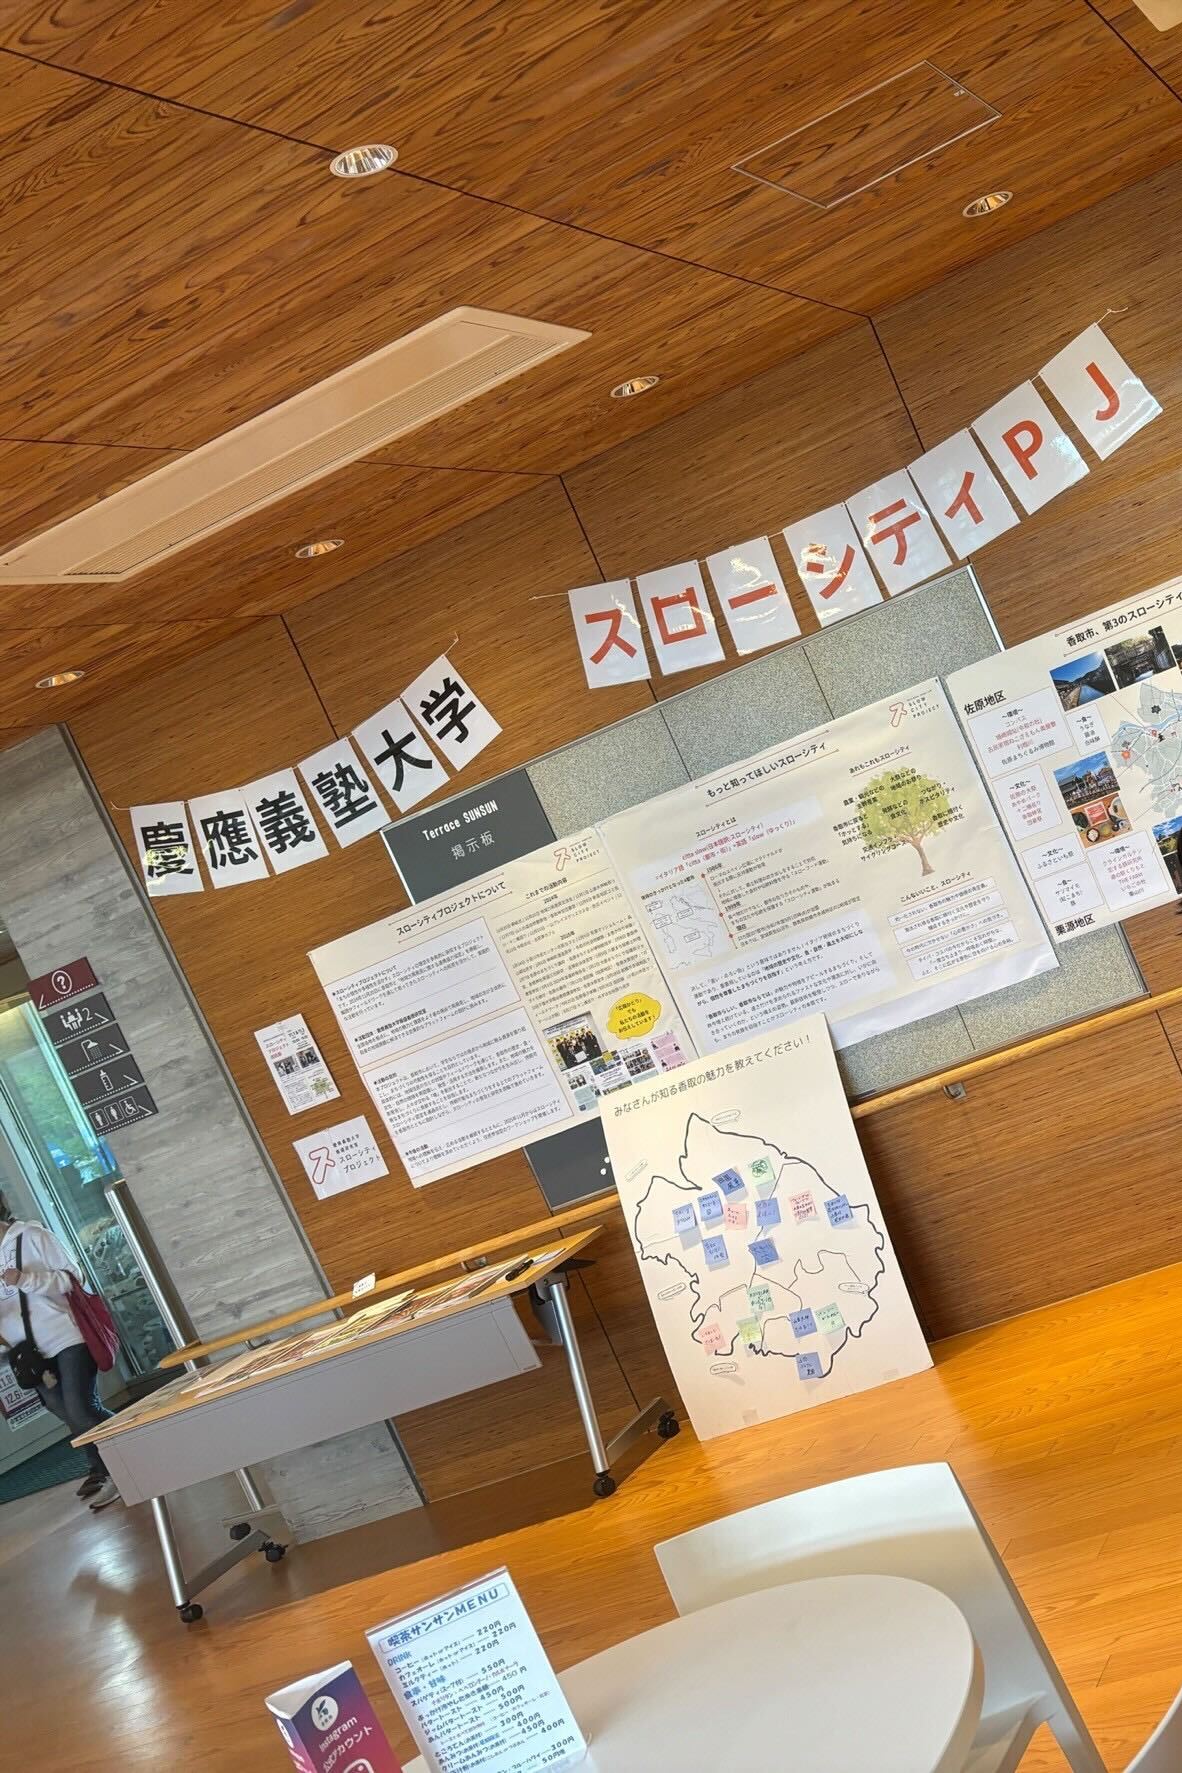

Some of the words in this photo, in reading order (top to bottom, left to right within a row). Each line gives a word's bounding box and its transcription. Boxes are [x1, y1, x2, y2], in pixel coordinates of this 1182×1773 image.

[962, 688, 1006, 716] 佐原地区
[139, 676, 478, 879] 慶應義塾大学
[705, 739, 828, 799] もっと知ってほしいスローシティ
[421, 816, 461, 842] Terrace
[461, 798, 499, 824] SUNSUN
[694, 815, 737, 838] スローシティとは
[450, 829, 495, 860] 掲示板
[395, 879, 507, 937] スローシティプロジェクトについて
[1054, 912, 1096, 937] 栗源地区
[80, 1006, 93, 1021] 2
[612, 1031, 813, 1119] みなさんが知る香取の魅力を教えてください！
[337, 1144, 375, 1164] スローシティ
[342, 1153, 380, 1173] プロジェクト
[386, 1587, 500, 1649] 喫茶サンサンMENU
[394, 1657, 420, 1674] コーヒー
[475, 1619, 502, 1636] 220円
[398, 1659, 435, 1682] カフェオーレ
[490, 1621, 517, 1639] 220円
[474, 1637, 500, 1655] 220円
[480, 1656, 506, 1674] 550円
[420, 1704, 463, 1729] バタートースト
[478, 1683, 505, 1702] 450円
[424, 1702, 483, 1736] ジャムバタートースト
[499, 1682, 525, 1701] 500円
[427, 1712, 481, 1744] あんバタートースト
[497, 1692, 523, 1711] 500円
[498, 1709, 524, 1728] 300円
[515, 1710, 541, 1728] 400円
[317, 1716, 359, 1752] Instagram
[519, 1717, 545, 1736] 450円
[539, 1716, 565, 1734] 400円
[549, 1733, 575, 1752] 300円
